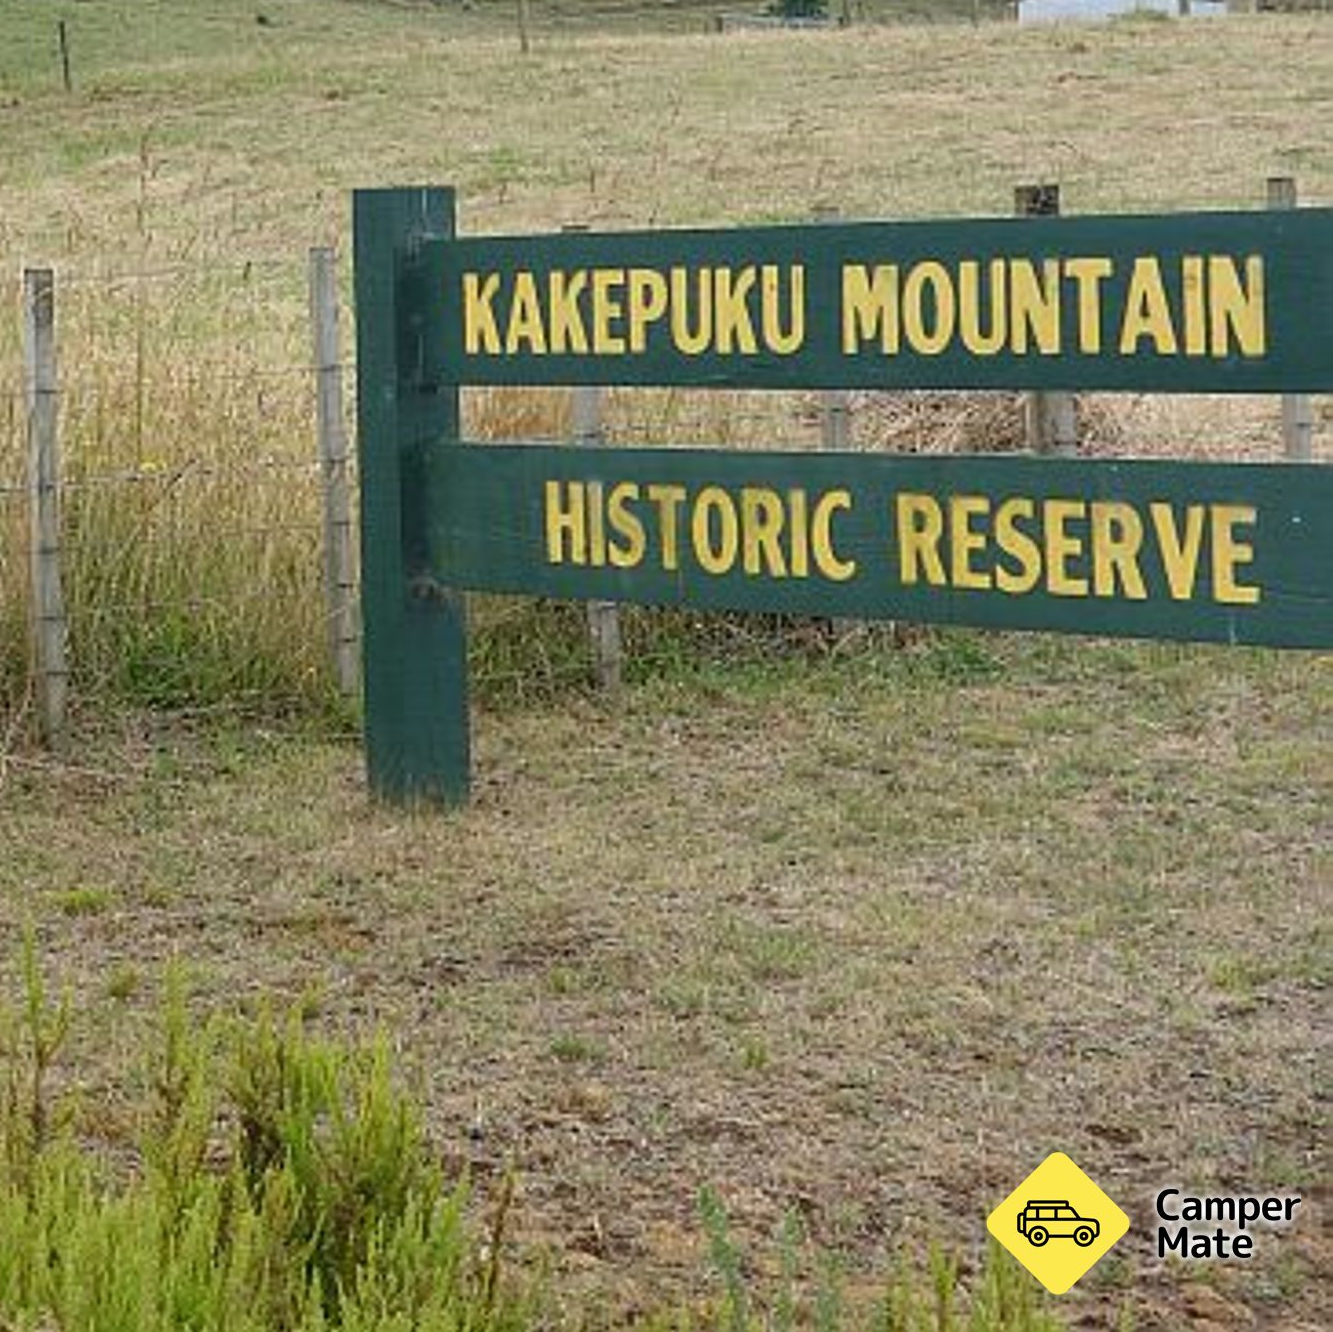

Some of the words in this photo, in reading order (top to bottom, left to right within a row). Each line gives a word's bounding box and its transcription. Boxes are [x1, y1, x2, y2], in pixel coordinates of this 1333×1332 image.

[463, 263, 806, 356] KAKEPUKU
[843, 255, 1267, 358] MOUNTAIN
[545, 481, 856, 581] HISTORIC
[897, 494, 1261, 604] RESERVE
